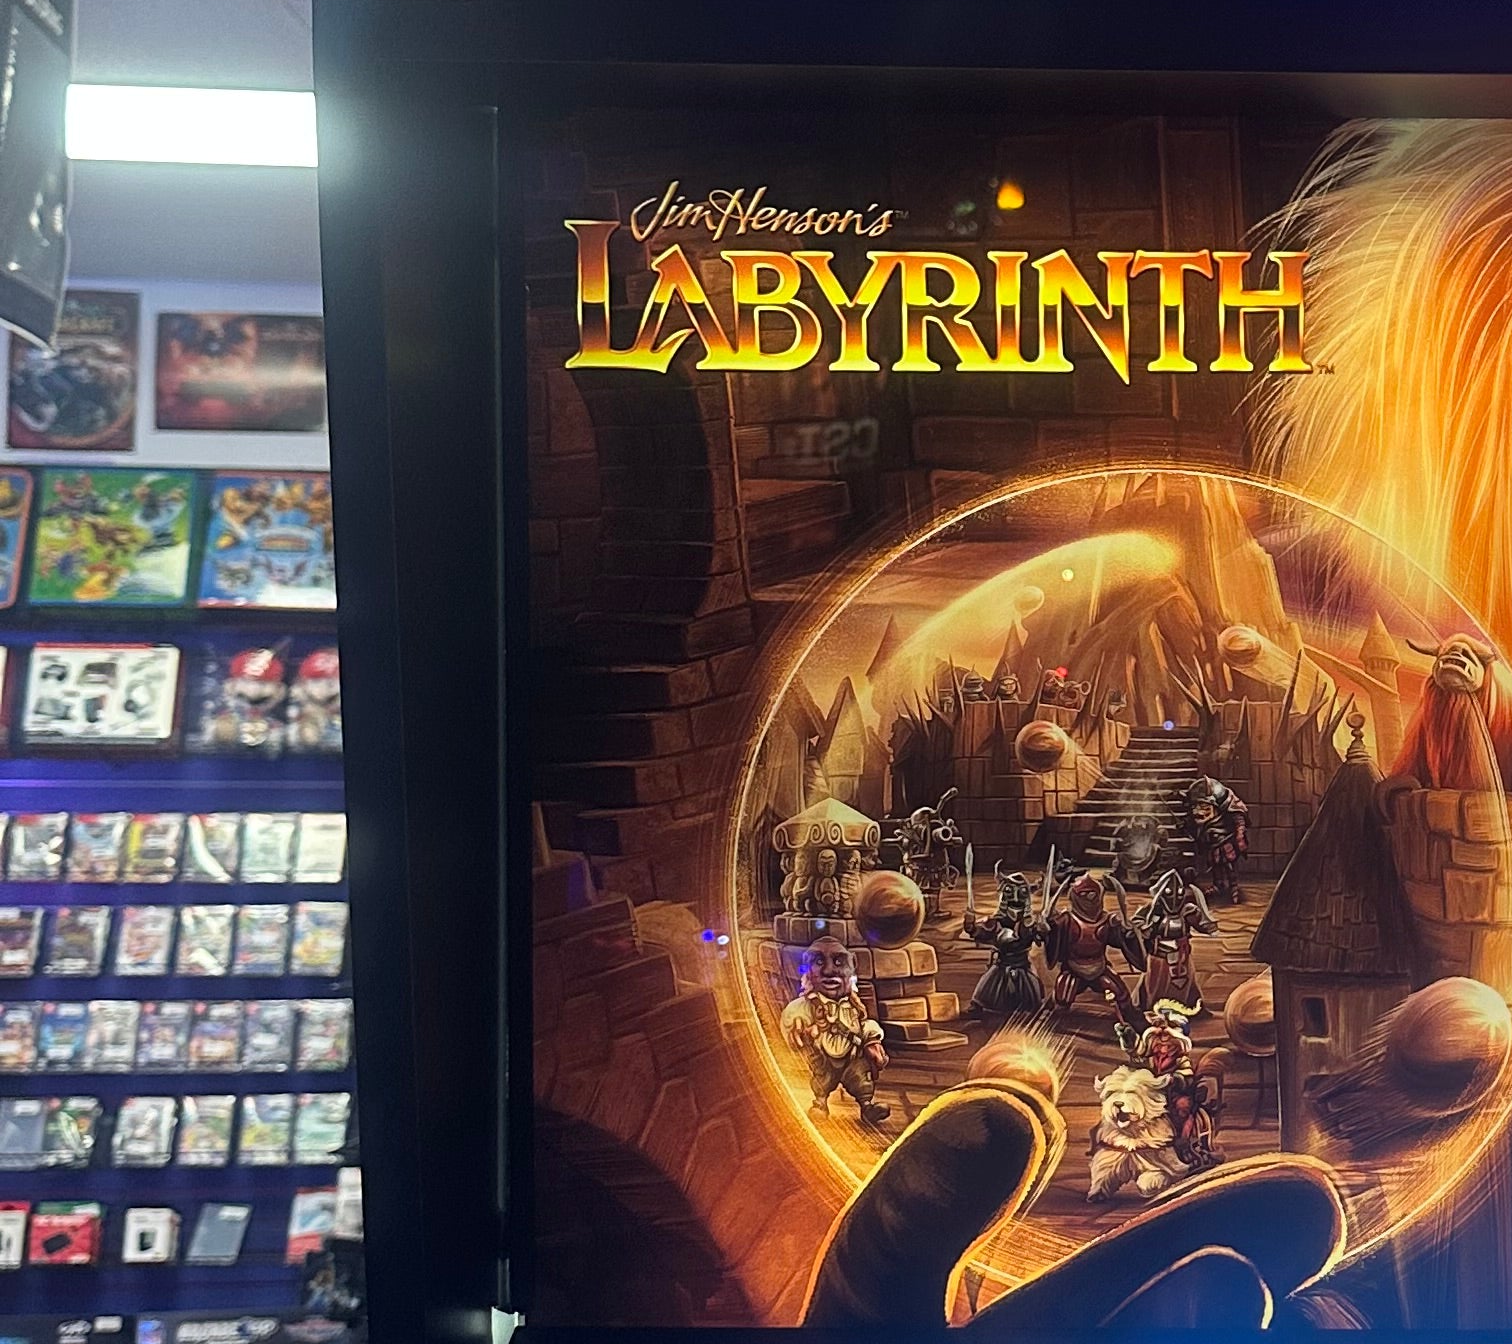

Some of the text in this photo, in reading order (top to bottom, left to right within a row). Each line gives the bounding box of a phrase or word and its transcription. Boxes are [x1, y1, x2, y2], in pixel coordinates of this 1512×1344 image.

[631, 181, 717, 241] Jim
[709, 187, 893, 241] Henson's
[564, 218, 1314, 385] LABYRINTH
